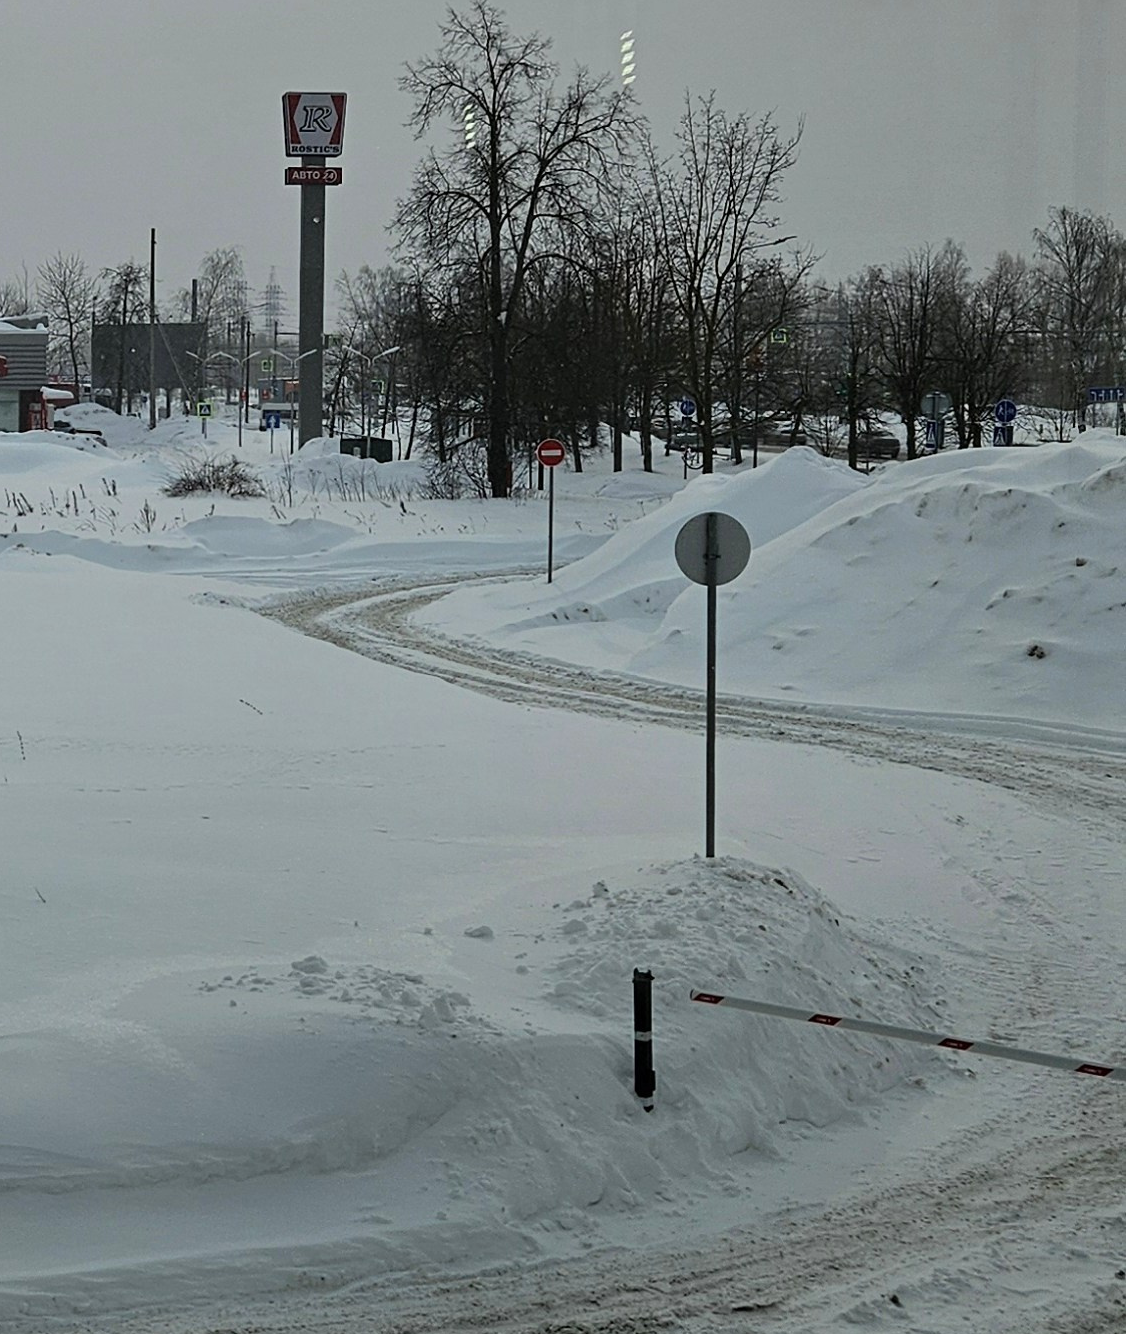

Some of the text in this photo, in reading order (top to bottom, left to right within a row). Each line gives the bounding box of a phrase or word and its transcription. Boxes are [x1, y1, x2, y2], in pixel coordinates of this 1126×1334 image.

[299, 106, 333, 132] R
[291, 145, 340, 154] ROSTIC'S
[292, 170, 321, 180] АВТО
